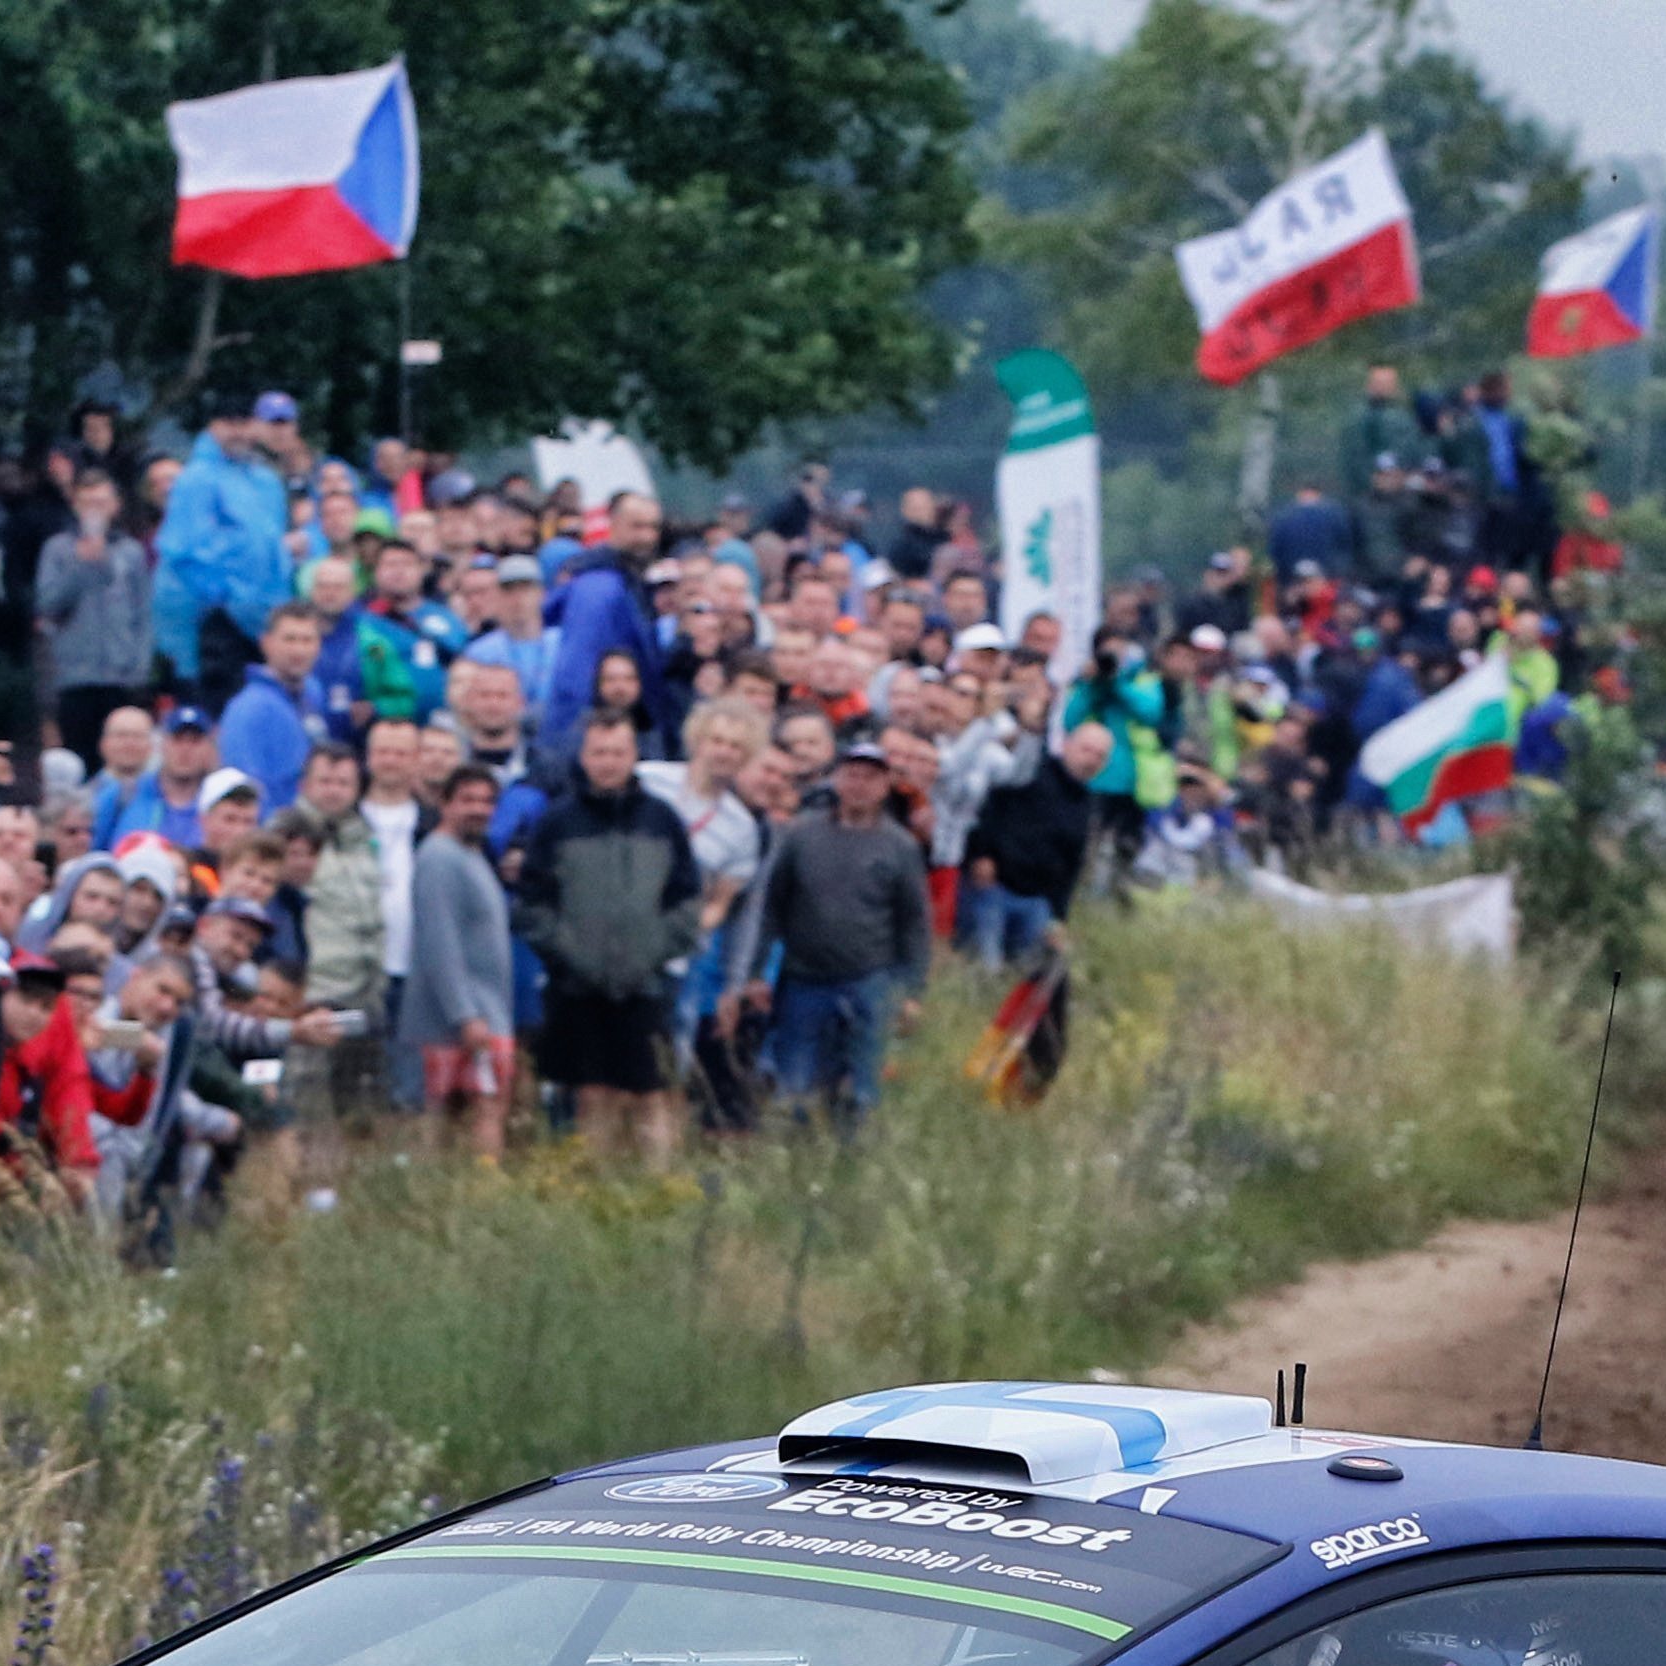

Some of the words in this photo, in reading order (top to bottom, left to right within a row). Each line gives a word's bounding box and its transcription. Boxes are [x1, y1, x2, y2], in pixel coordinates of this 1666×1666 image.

[817, 1478, 976, 1504] Powered
[967, 1489, 1024, 1510] by
[516, 1519, 576, 1535] FIA
[571, 1519, 661, 1539] World
[658, 1522, 744, 1545] Rally
[740, 1529, 962, 1571] Championship
[766, 1489, 1133, 1553] EcoBoost
[1310, 1516, 1430, 1568] sparco
